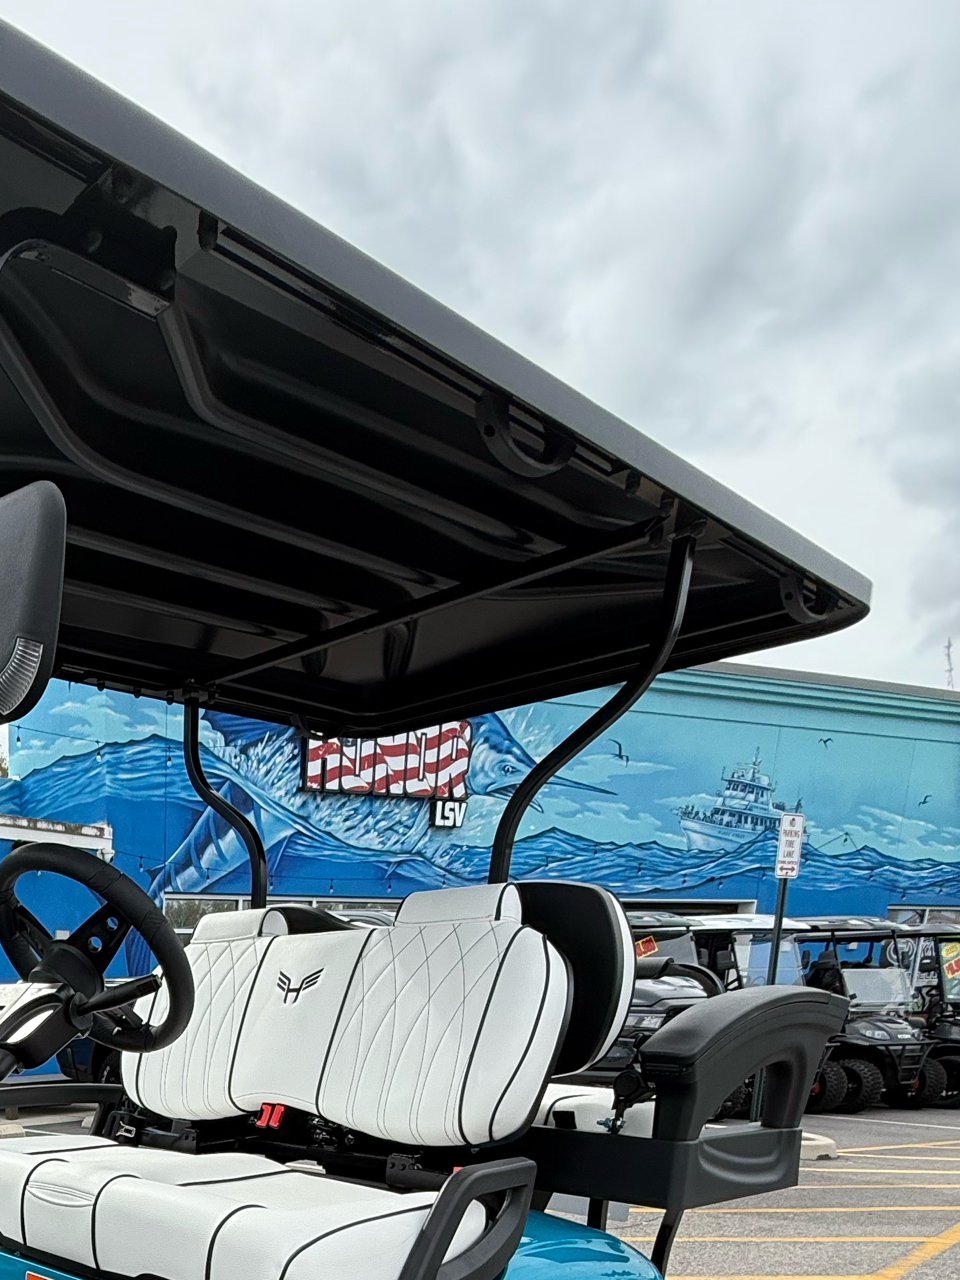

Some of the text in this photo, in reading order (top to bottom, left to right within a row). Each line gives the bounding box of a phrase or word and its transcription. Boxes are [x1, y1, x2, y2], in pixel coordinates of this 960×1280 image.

[434, 801, 467, 828] LSV
[782, 829, 800, 839] PARKING
[785, 840, 796, 849] FIRE
[783, 850, 795, 859] LANE
